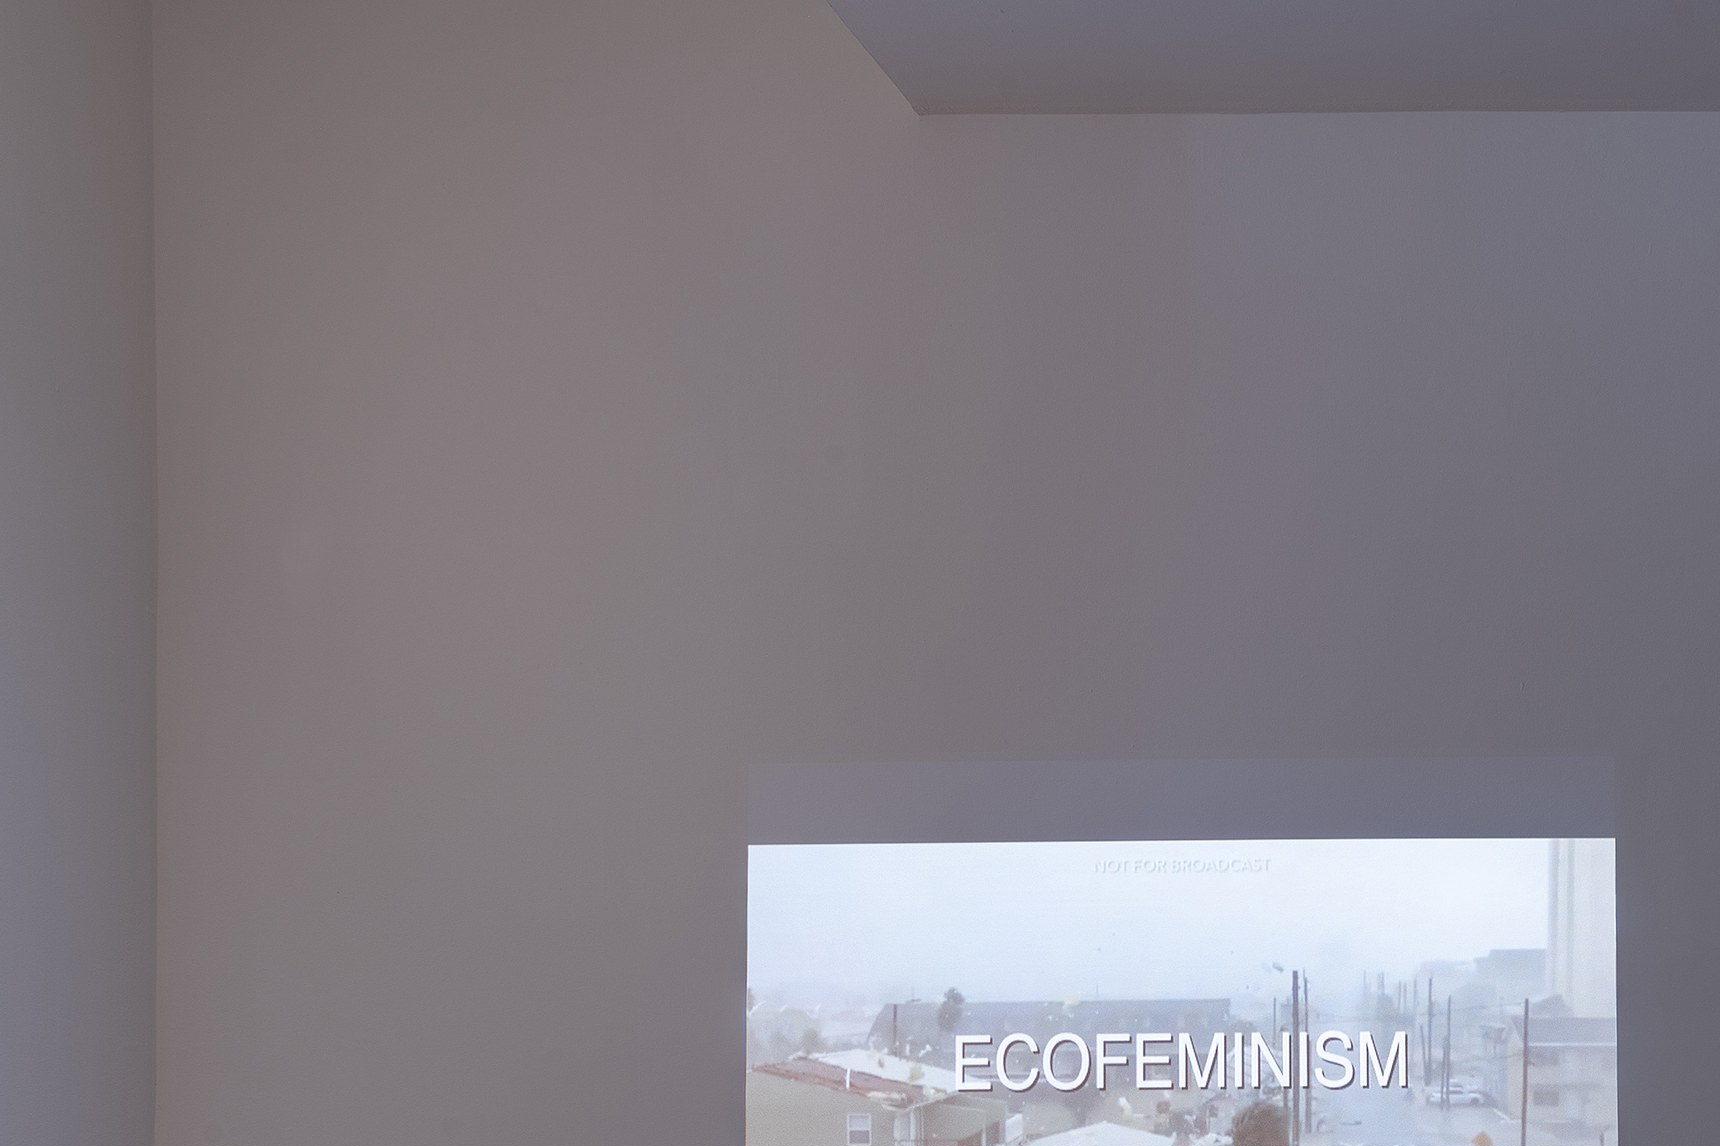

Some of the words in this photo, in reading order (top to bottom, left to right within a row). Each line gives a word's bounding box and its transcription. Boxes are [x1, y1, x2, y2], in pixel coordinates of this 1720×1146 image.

[1095, 859, 1129, 874] NOT
[1133, 859, 1167, 873] FOR
[1171, 858, 1273, 873] BROADCAST
[955, 1030, 1408, 1092] ECOFEMINISM
